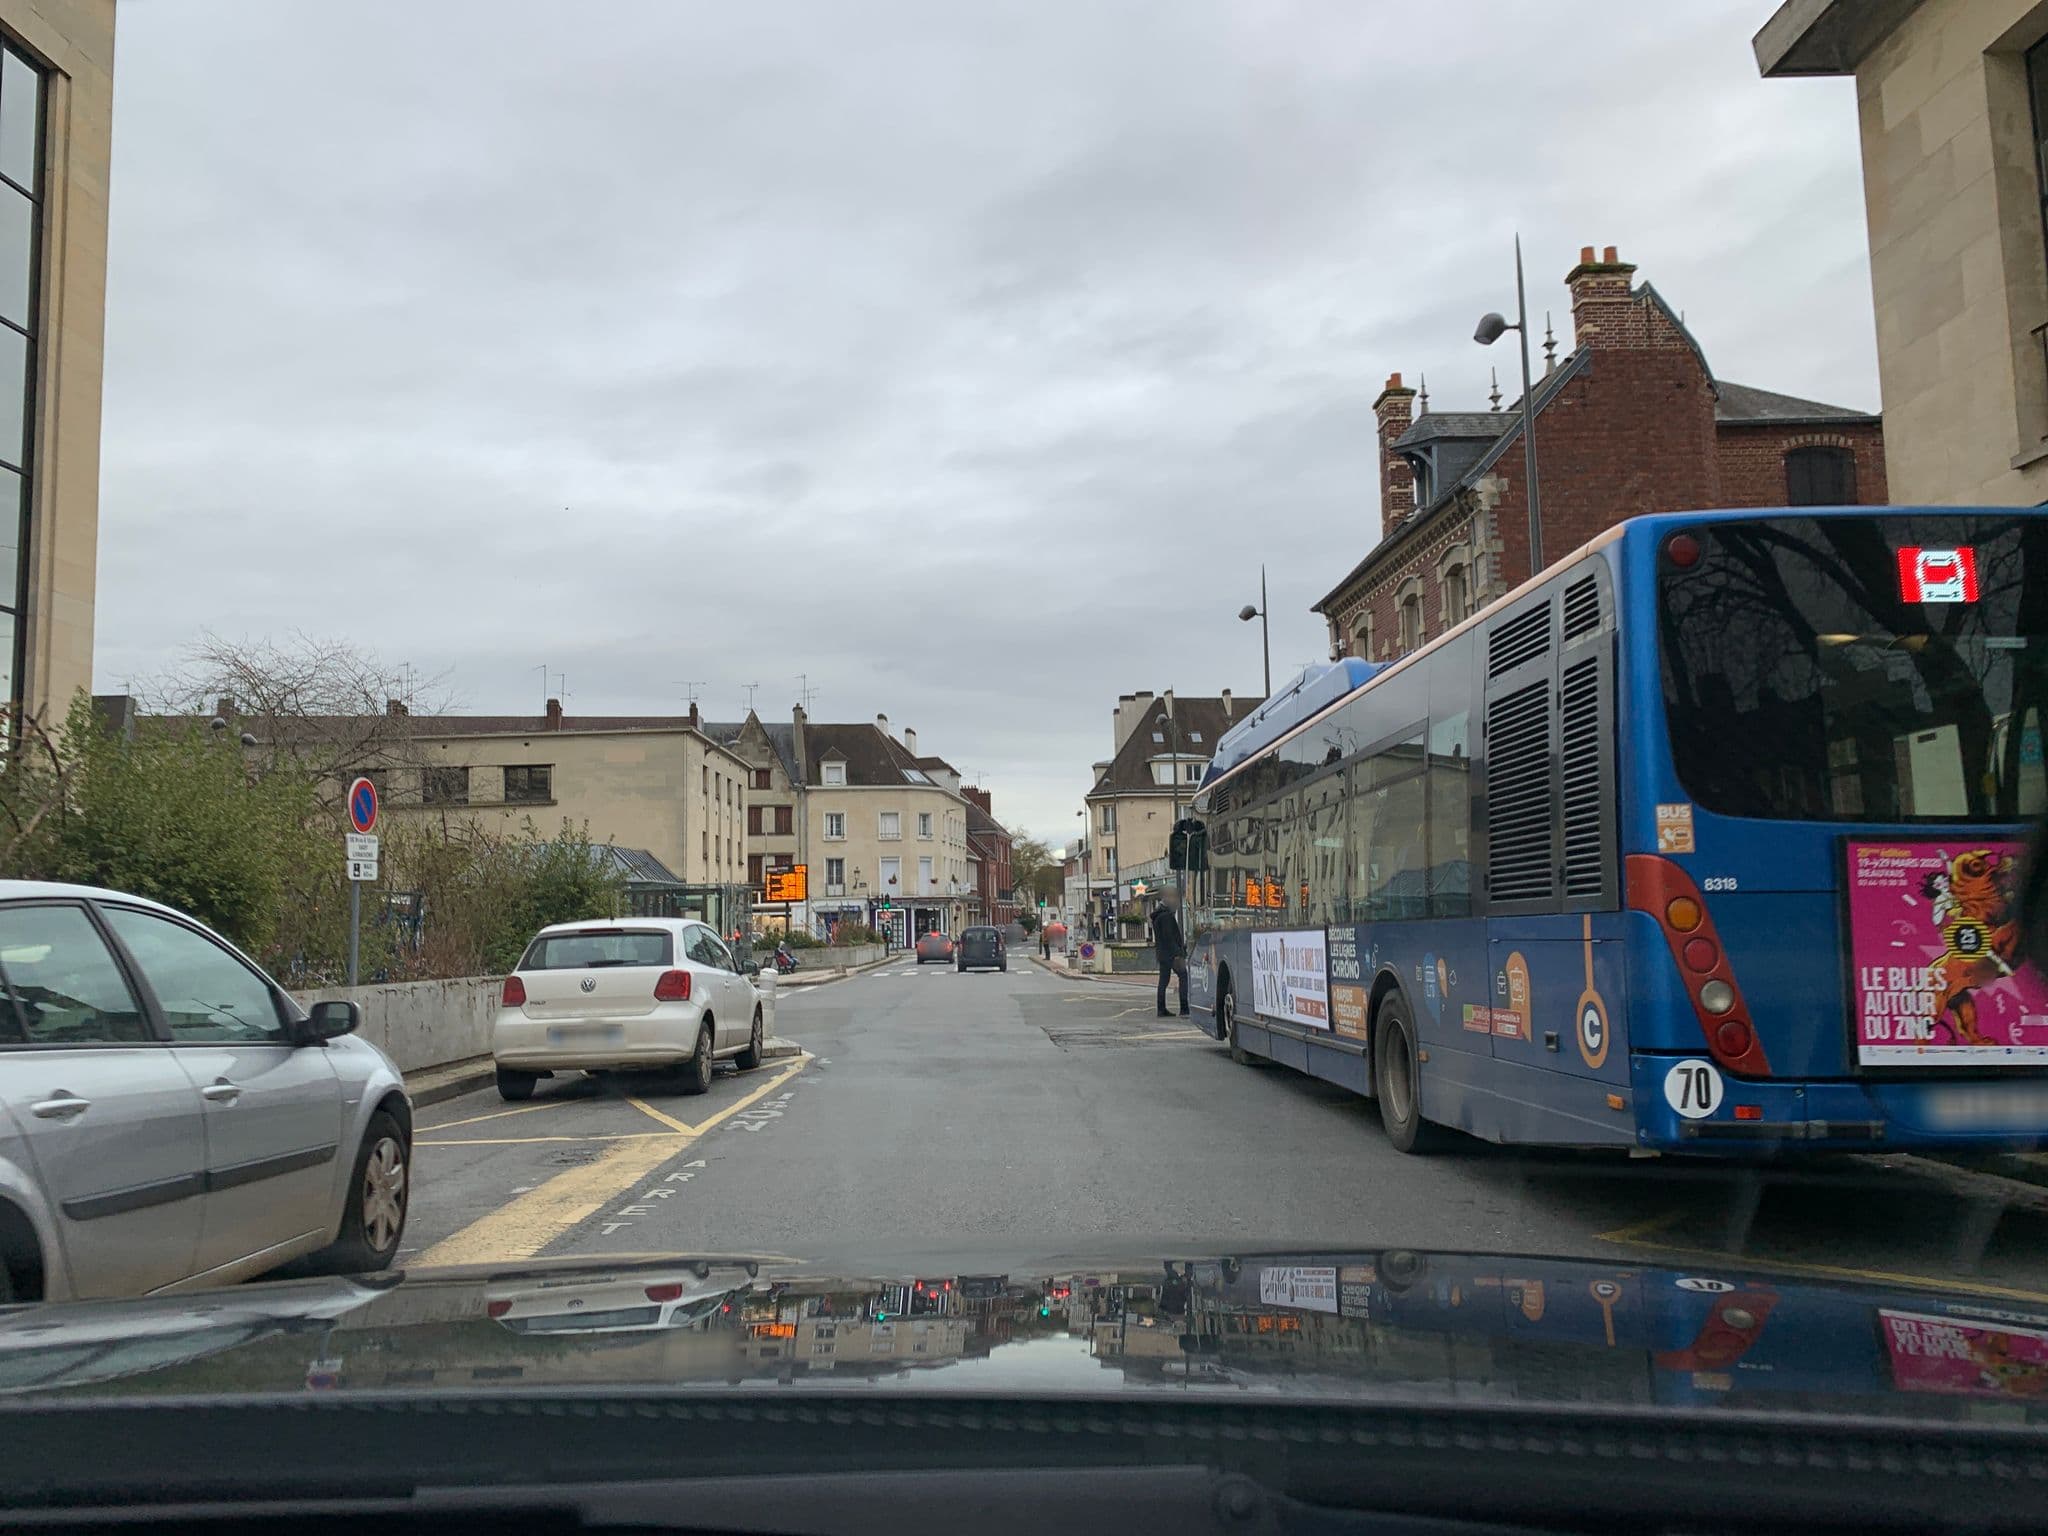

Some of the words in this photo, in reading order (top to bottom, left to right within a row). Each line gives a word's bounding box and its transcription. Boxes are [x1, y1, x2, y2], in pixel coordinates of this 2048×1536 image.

[1657, 805, 1691, 818] BUS
[1704, 877, 1738, 891] 8318
[1256, 938, 1279, 972] Salon
[1862, 967, 1886, 991] LE
[1887, 967, 1948, 992] BLUES
[1864, 991, 1938, 1016] AUTOUR
[1583, 1009, 1601, 1048] C
[1864, 1016, 1891, 1040] DU
[1893, 1016, 1937, 1040] ZINC
[1677, 1067, 1711, 1109] 70
